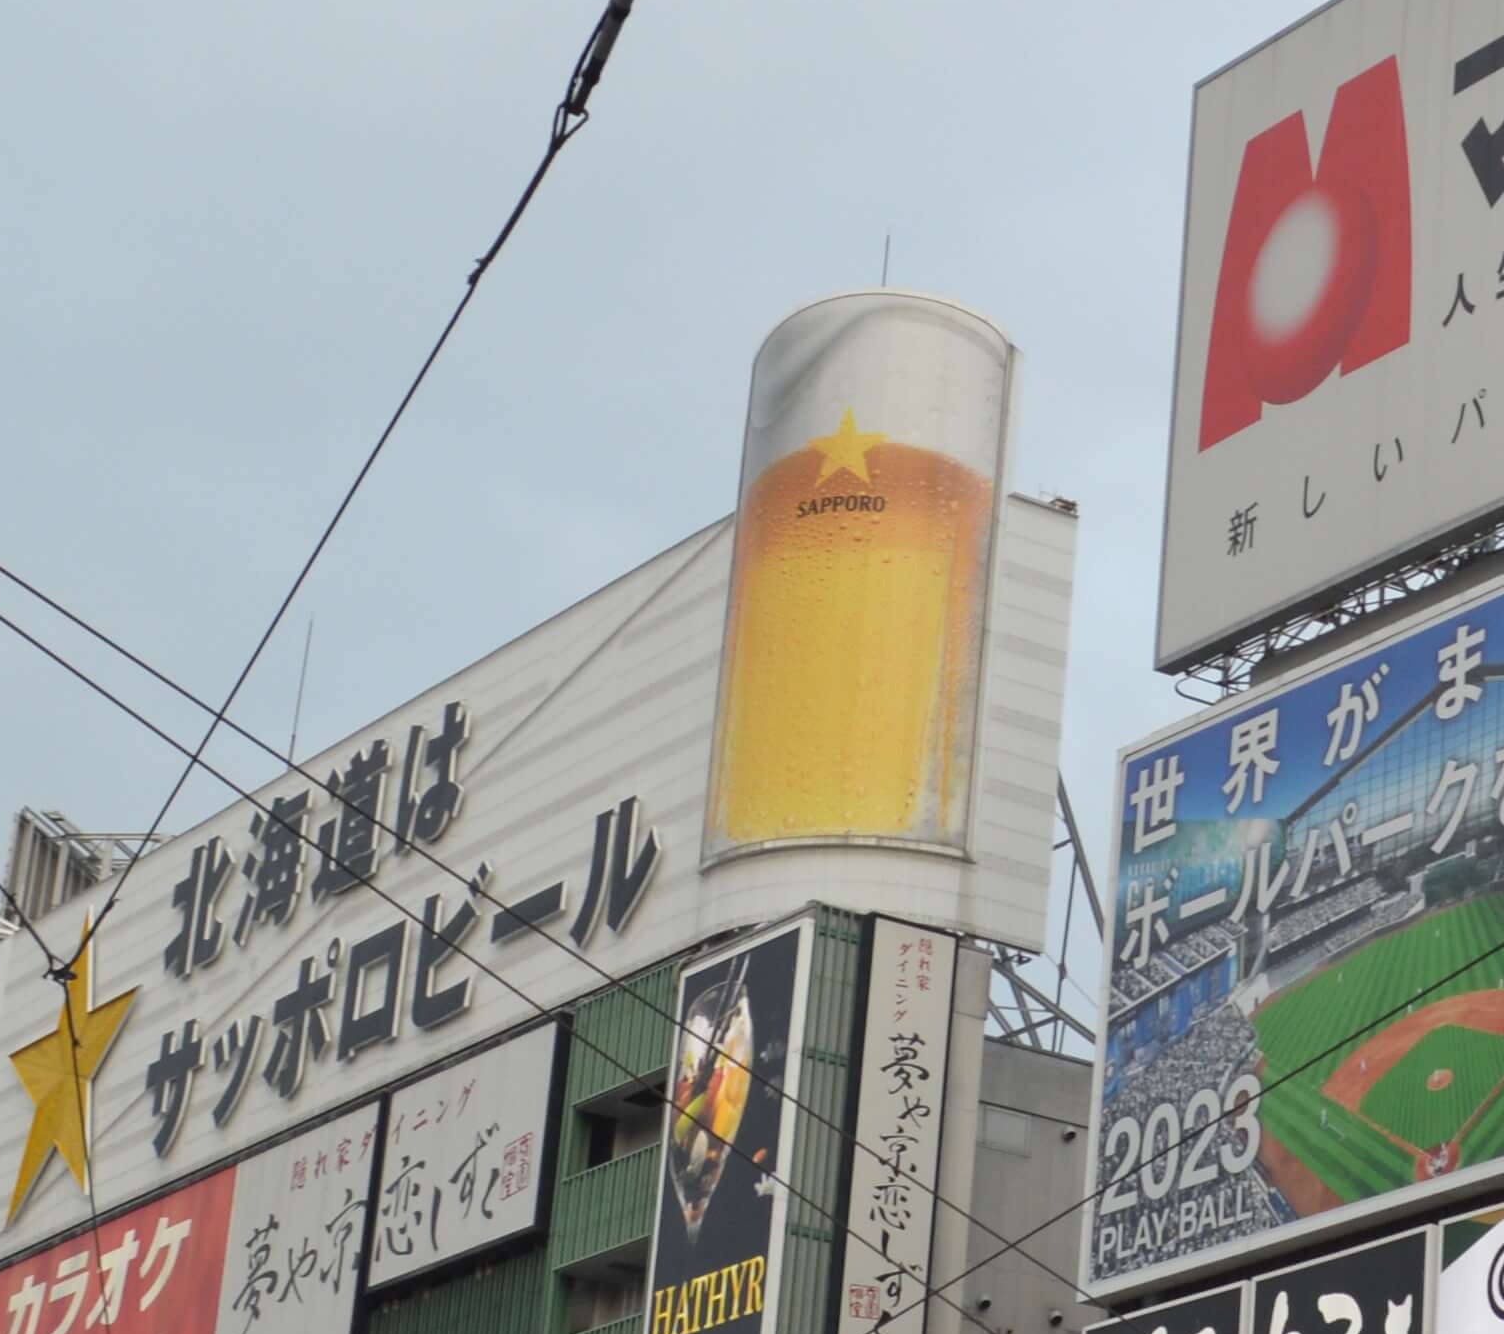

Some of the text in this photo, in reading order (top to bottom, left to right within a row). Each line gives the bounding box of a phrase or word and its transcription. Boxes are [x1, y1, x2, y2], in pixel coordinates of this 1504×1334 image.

[797, 493, 886, 517] SAPPORO
[163, 707, 467, 980] 北海道は
[147, 795, 661, 1158] サッポロビール
[1097, 1074, 1261, 1213] 2023
[1100, 1192, 1254, 1266] PLAY BALL
